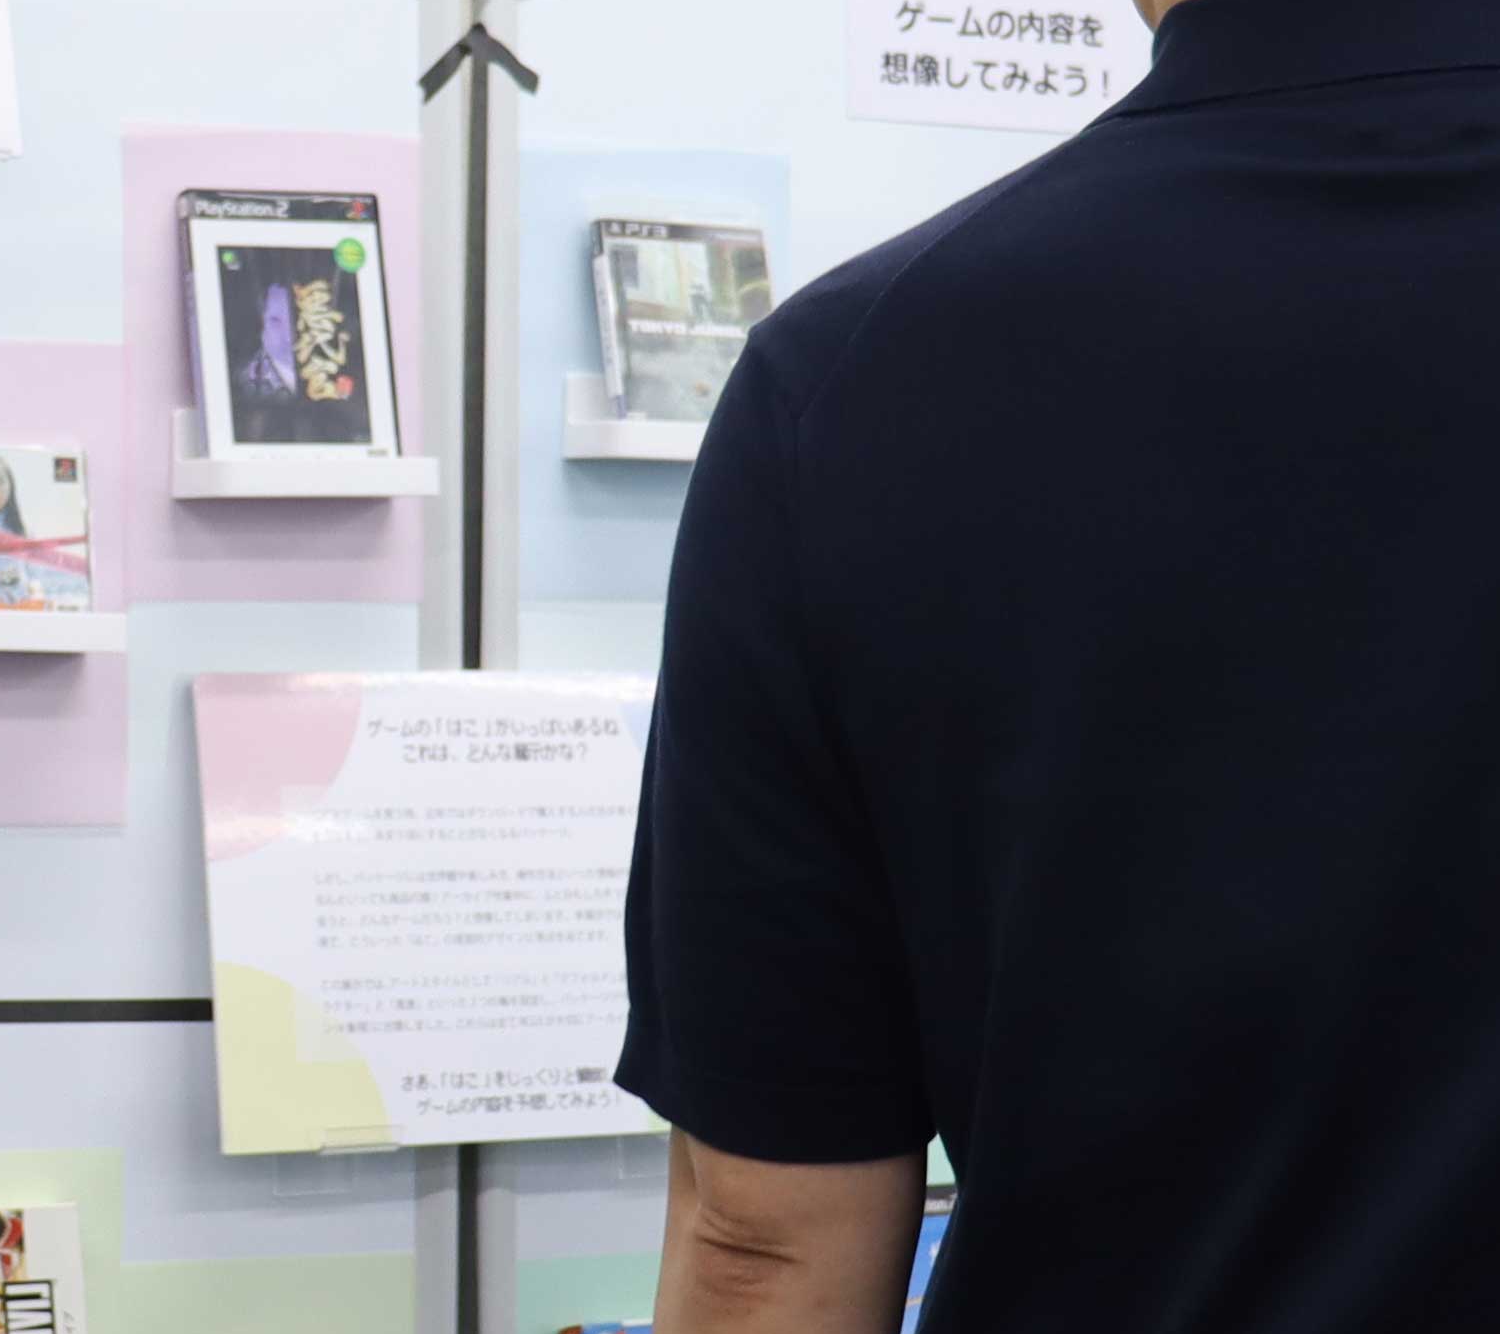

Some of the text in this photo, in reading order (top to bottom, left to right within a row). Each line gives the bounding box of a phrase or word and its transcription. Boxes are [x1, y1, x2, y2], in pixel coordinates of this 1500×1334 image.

[894, 0, 1105, 48] ゲームの内容を
